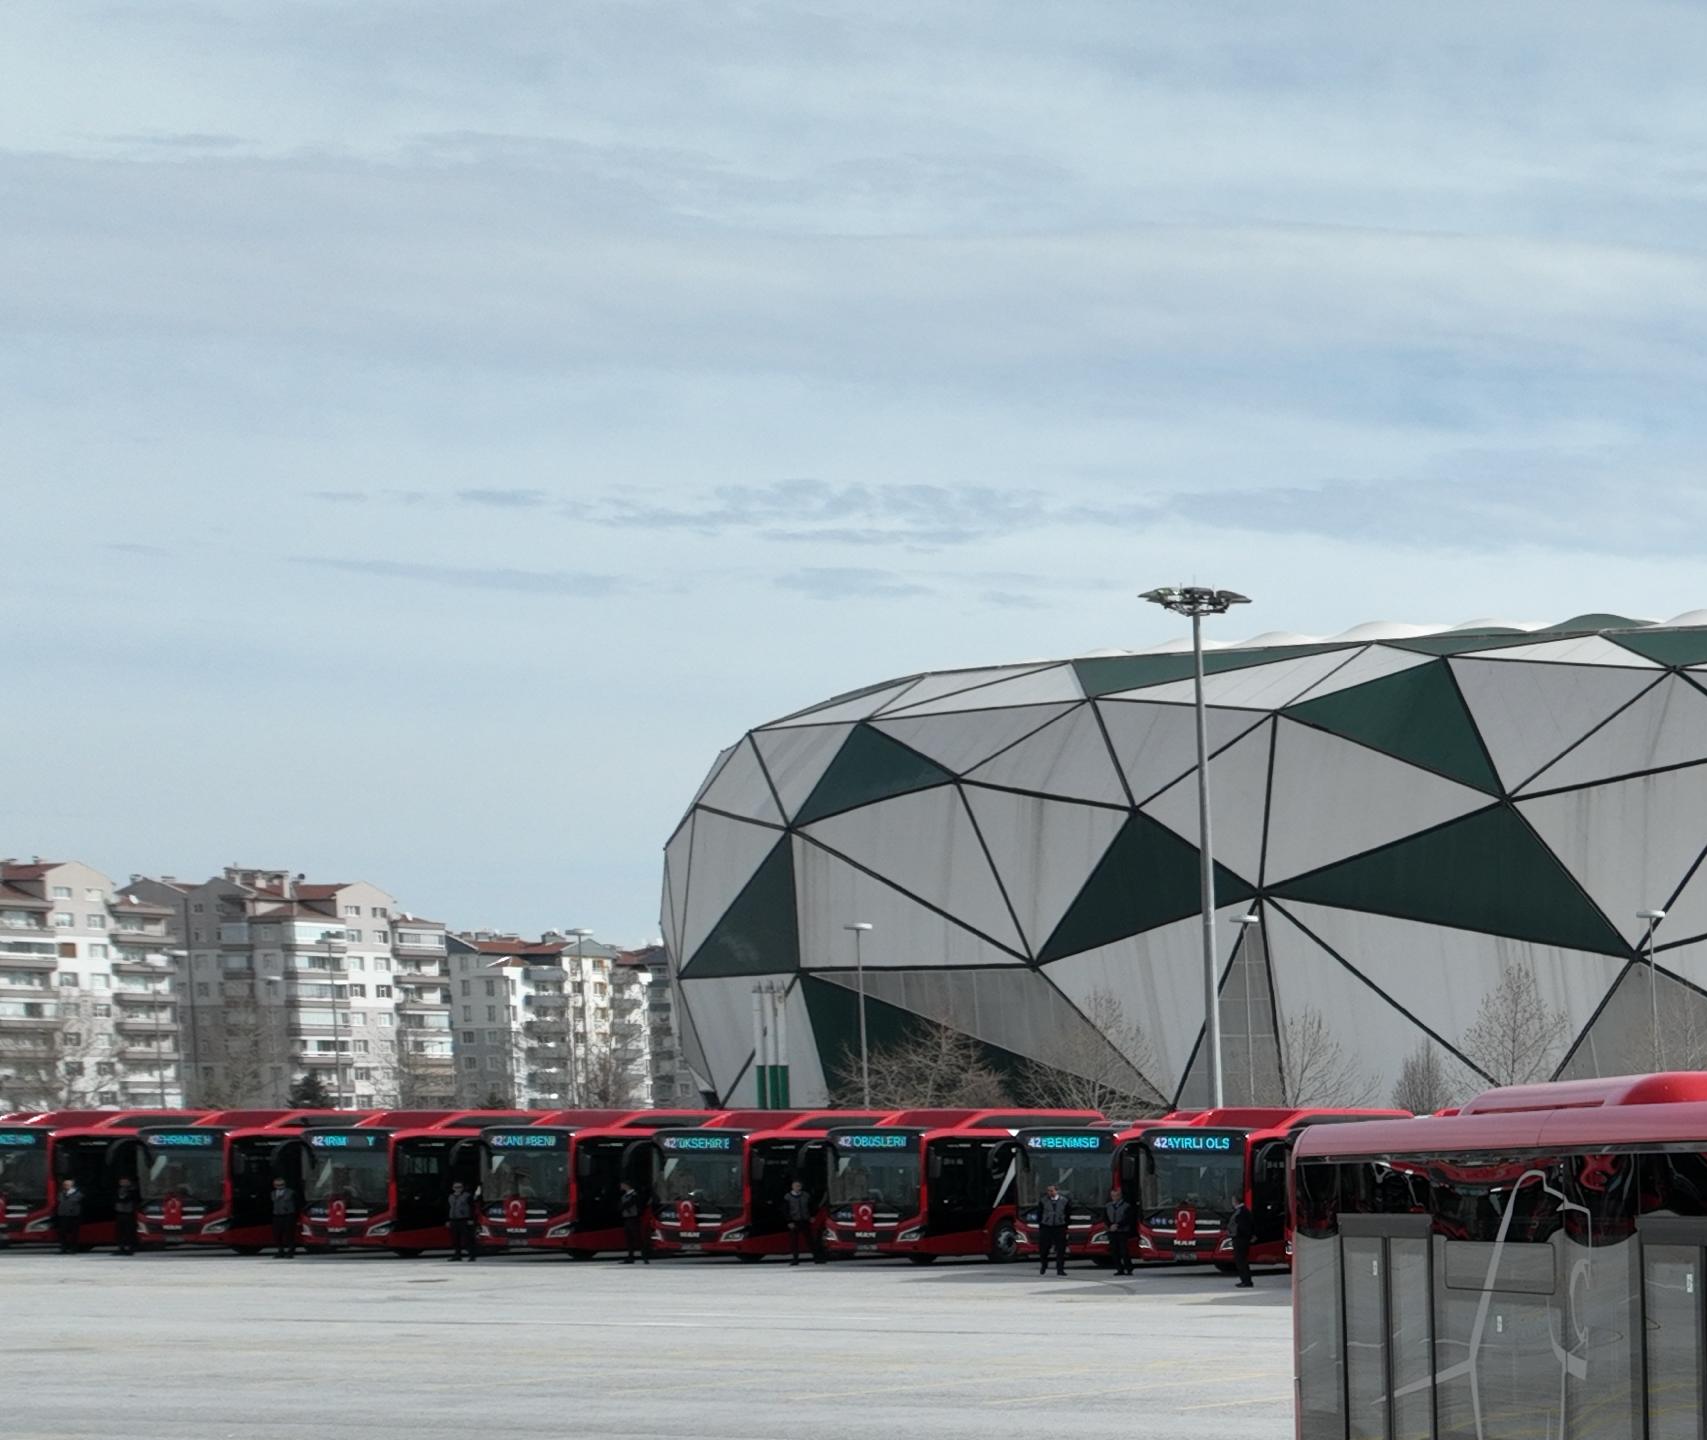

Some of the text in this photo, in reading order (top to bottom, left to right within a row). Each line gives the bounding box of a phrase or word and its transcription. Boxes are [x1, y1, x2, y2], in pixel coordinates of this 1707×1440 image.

[663, 1137, 676, 1149] 42
[838, 1135, 851, 1147] 42
[1028, 1136, 1041, 1148] 42
[1153, 1137, 1168, 1149] 42
